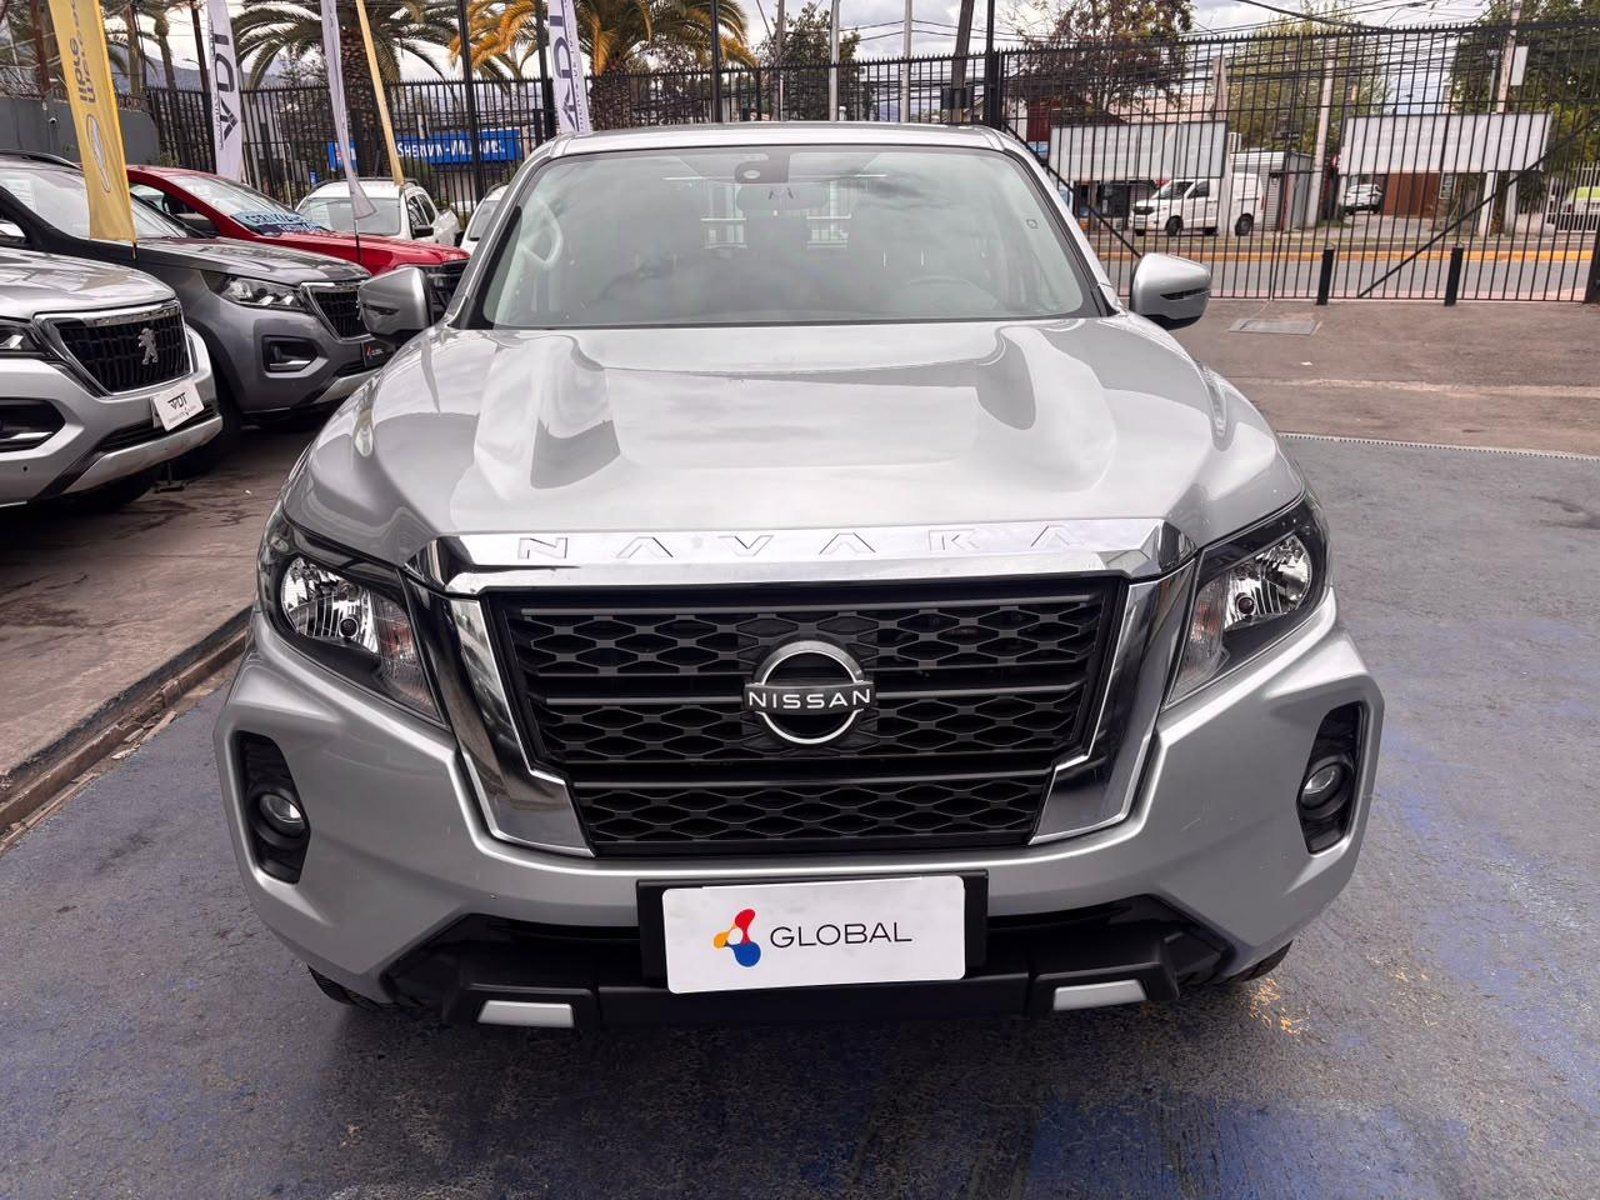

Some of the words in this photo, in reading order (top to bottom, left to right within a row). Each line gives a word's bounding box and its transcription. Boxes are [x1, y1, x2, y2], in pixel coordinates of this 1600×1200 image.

[517, 525, 1085, 560] NAVARA
[749, 689, 871, 710] NISSAN
[770, 922, 913, 949] GLOBAL
